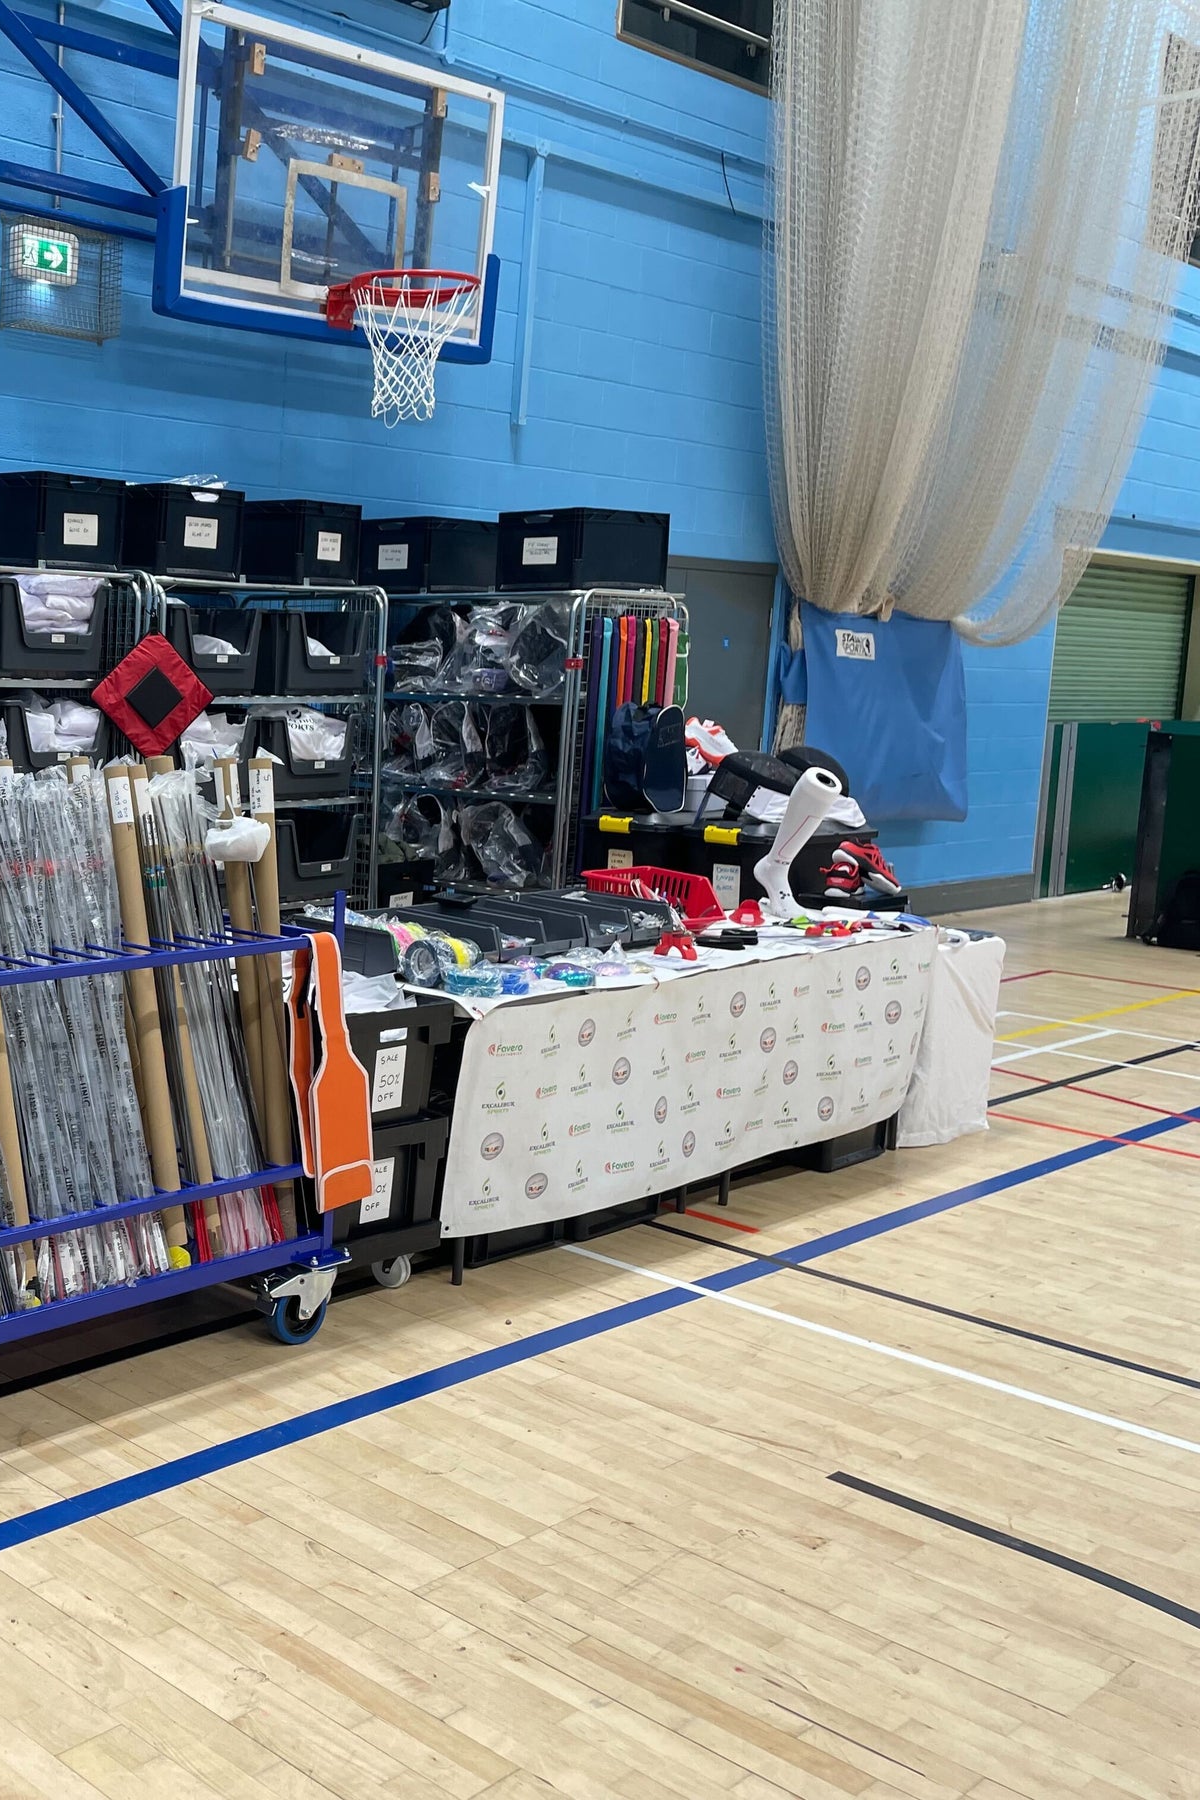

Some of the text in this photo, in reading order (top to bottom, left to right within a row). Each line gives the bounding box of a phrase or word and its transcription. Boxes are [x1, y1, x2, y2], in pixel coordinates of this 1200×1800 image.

[496, 1044, 523, 1053] Favero
[380, 1053, 399, 1066] SALE
[378, 1072, 400, 1089] 50%
[377, 1091, 394, 1103] OFF
[481, 1101, 515, 1109] EXCALIBUR
[374, 1165, 388, 1174] ALE
[612, 1161, 635, 1170] Favero
[65, 1176, 76, 1203] UNIC
[375, 1183, 387, 1194] 0%
[365, 1201, 380, 1212] OFF
